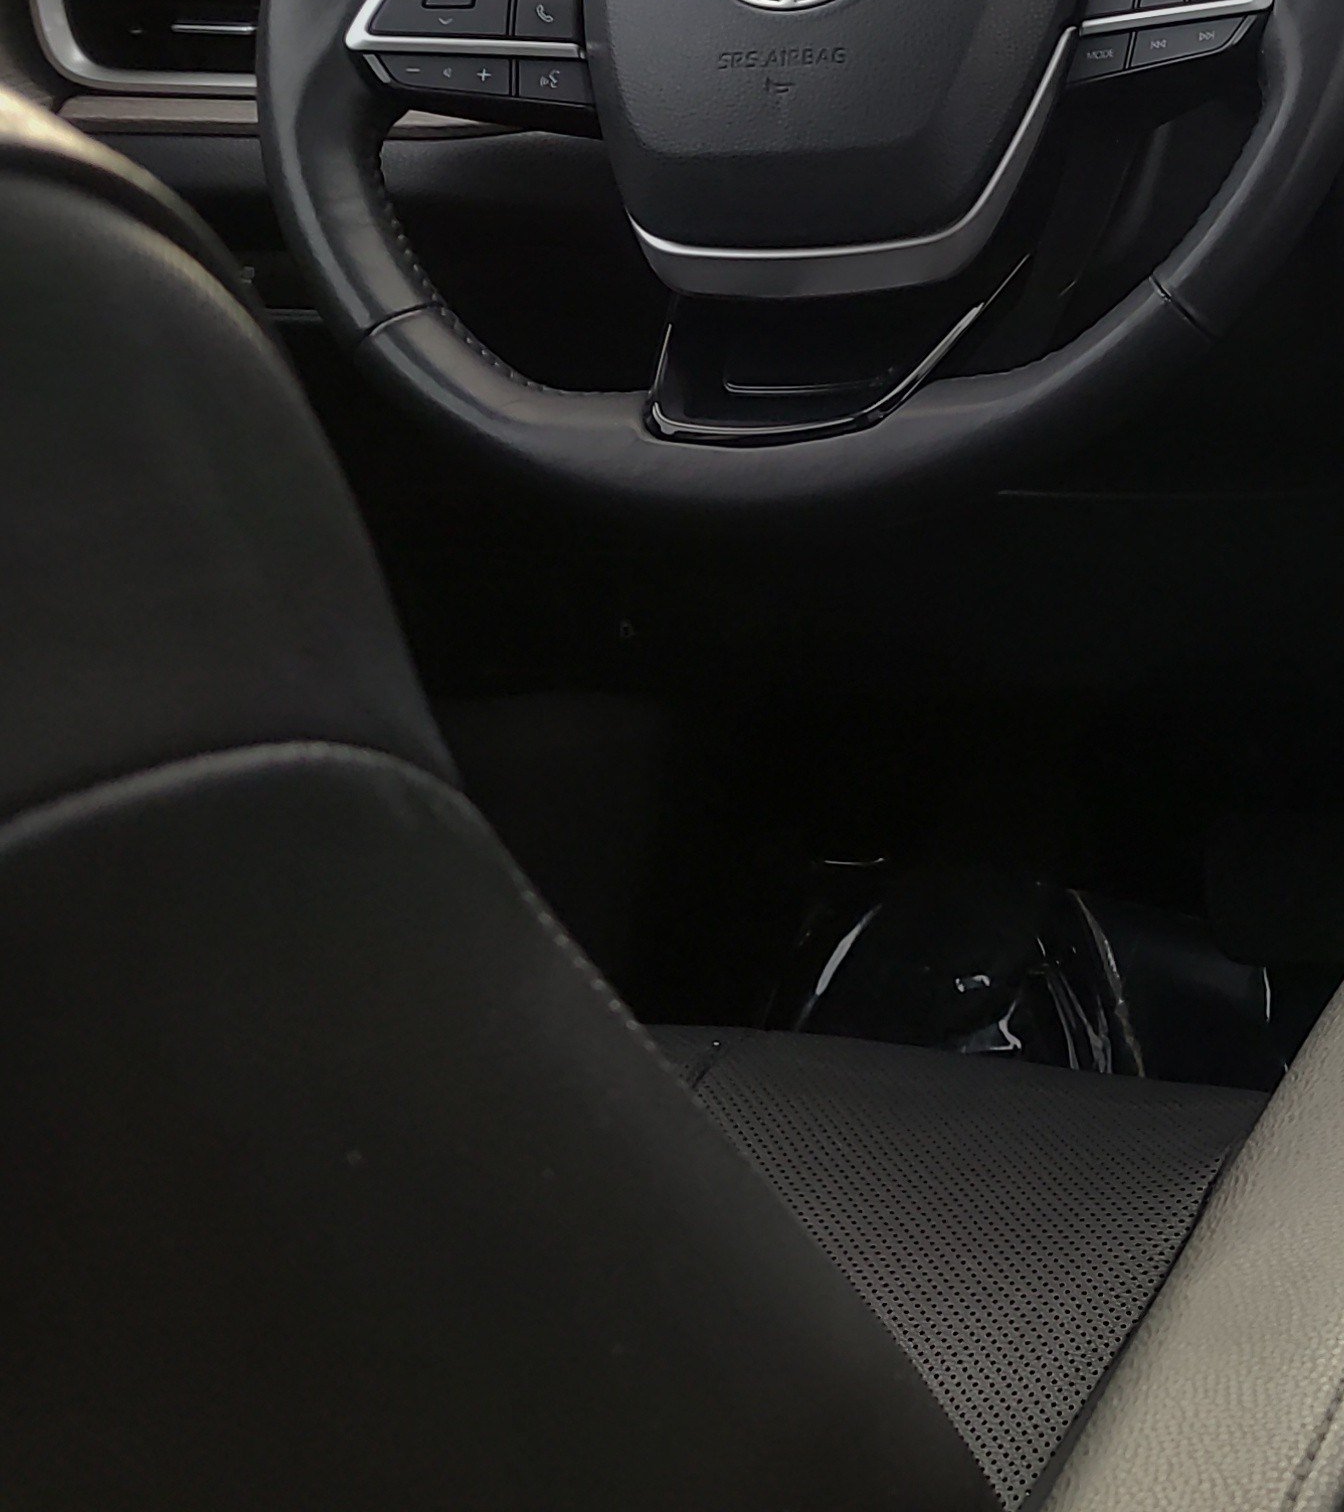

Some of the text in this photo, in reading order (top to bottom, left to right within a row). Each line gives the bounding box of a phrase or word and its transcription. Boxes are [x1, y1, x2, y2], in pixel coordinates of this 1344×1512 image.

[719, 47, 846, 70] SRS AIRBAG
[1087, 49, 1115, 60] MODE
